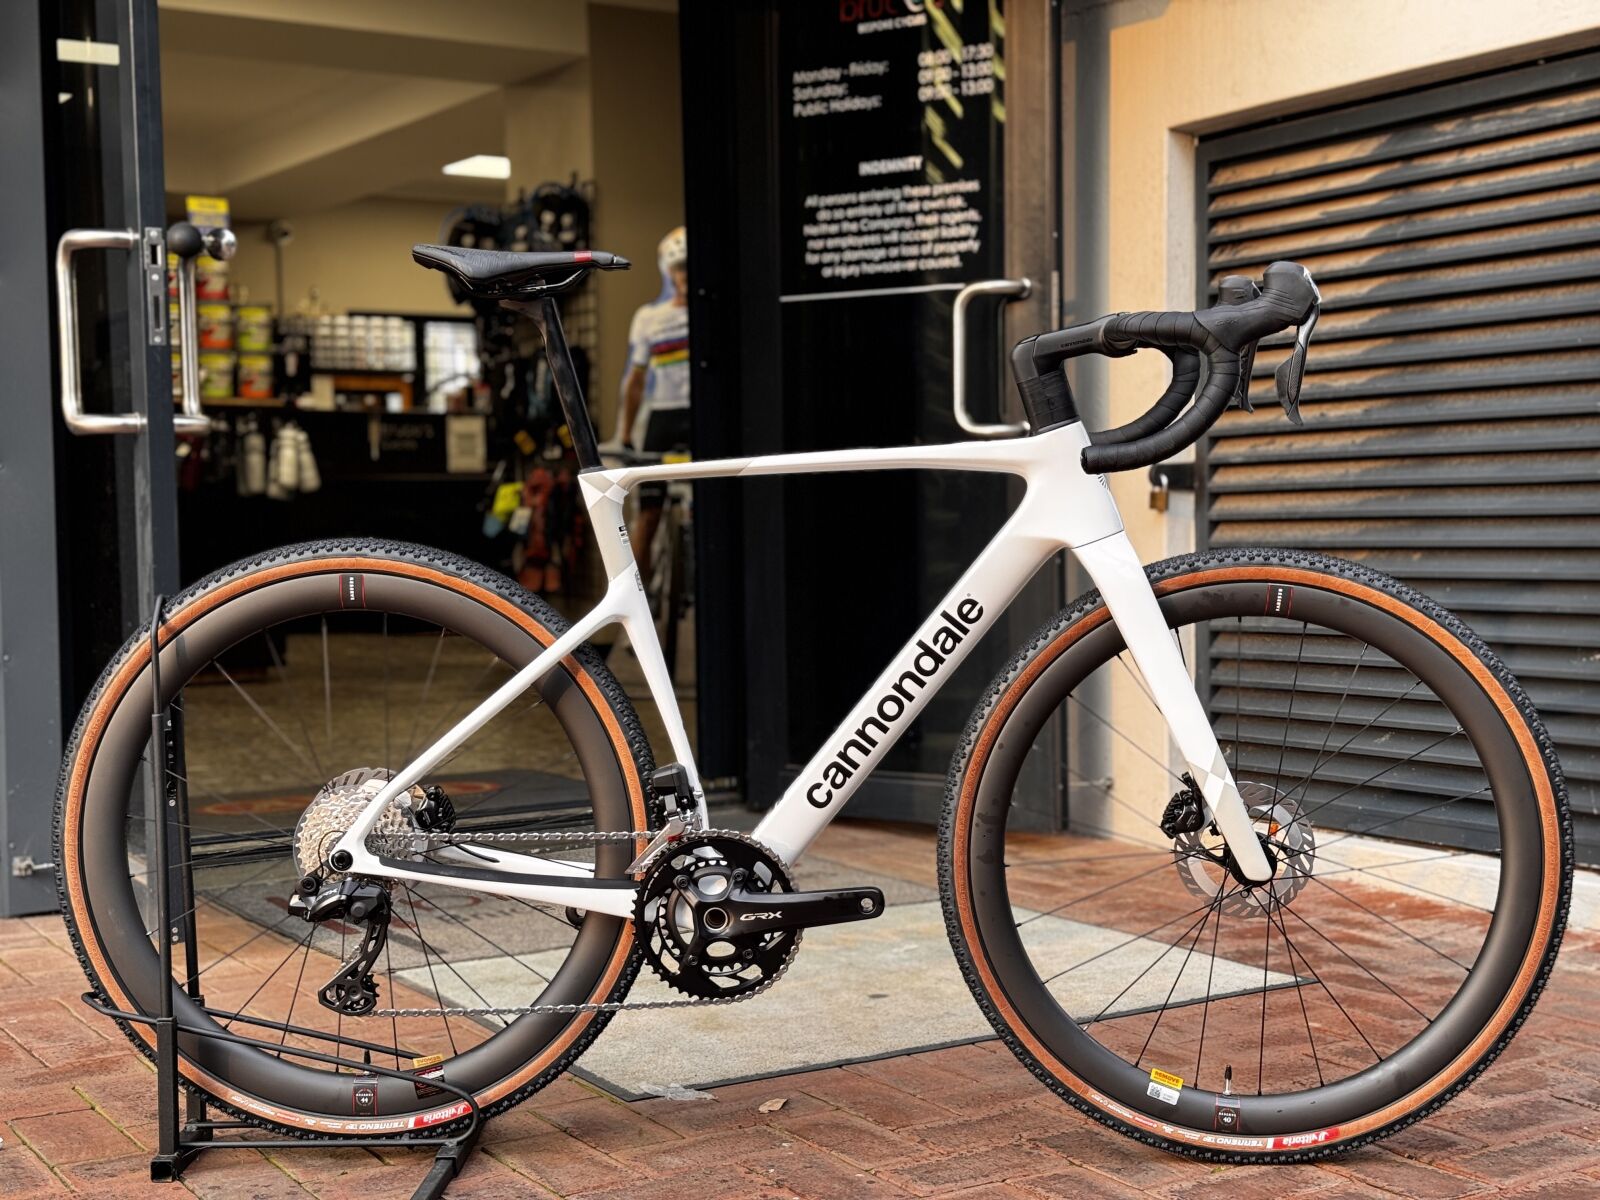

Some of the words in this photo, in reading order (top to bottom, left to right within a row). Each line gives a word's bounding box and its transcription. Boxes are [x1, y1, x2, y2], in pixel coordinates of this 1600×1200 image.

[793, 66, 842, 84] Monday
[849, 60, 890, 77] Friday:
[793, 82, 849, 102] Saturday:
[793, 101, 828, 118] Public
[829, 95, 882, 112] Holidays:
[858, 155, 923, 176] INDEMNITY
[804, 194, 818, 208] All
[819, 193, 857, 208] persons
[858, 188, 901, 202] entering
[902, 185, 931, 197] these
[932, 180, 980, 196] premises
[846, 205, 882, 219] entirely
[897, 200, 920, 213] their
[922, 200, 946, 211] own
[803, 223, 840, 236] Neither
[841, 220, 859, 233] the
[915, 212, 939, 225] their
[826, 234, 881, 249] employees
[882, 230, 899, 243] will
[900, 227, 940, 242] accept
[941, 223, 978, 239] liability
[805, 251, 819, 264] for
[821, 252, 841, 265] any
[841, 247, 887, 262] damage
[888, 246, 899, 258] or
[900, 244, 920, 257] loss
[920, 241, 933, 255] of
[933, 239, 980, 255] property
[834, 264, 860, 279] injury
[806, 596, 984, 809] cannondale
[740, 910, 782, 921] GRX
[1154, 1070, 1180, 1084] REMOVE
[358, 1120, 404, 1130] TERRENO
[424, 1108, 456, 1123] vittoria
[1216, 1138, 1264, 1146] TERRENO
[1282, 1133, 1318, 1146] vittoria
